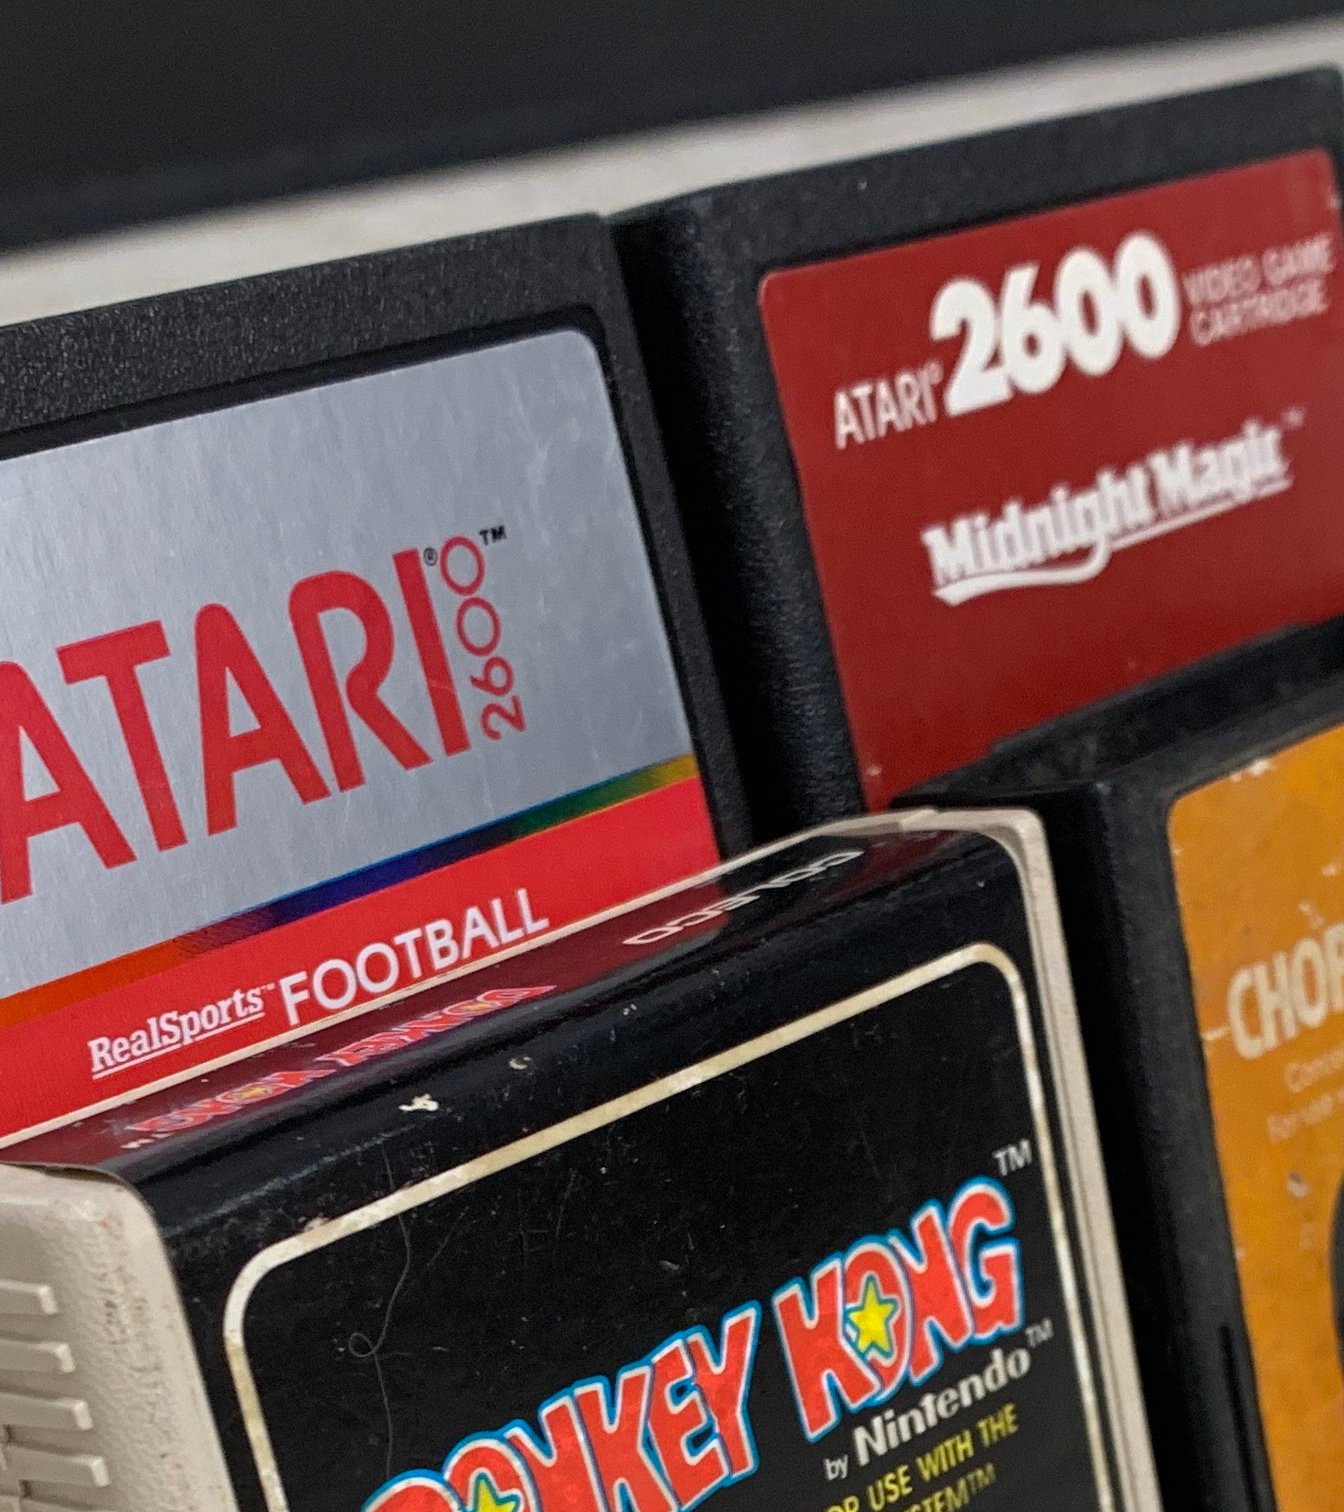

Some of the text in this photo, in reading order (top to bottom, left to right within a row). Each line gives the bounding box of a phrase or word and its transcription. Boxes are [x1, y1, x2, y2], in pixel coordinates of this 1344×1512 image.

[834, 228, 1181, 450] ATARI 2600
[1182, 254, 1261, 307] VIDEO
[920, 416, 1294, 604] Midnight Magic
[440, 534, 527, 742] 2600
[280, 888, 549, 1026] FOOTBALL
[774, 1175, 1026, 1442] KONG
[824, 1455, 848, 1480] by
[868, 1465, 912, 1511] USE
[916, 1430, 974, 1481] WITH
[977, 1403, 1018, 1447] THE
